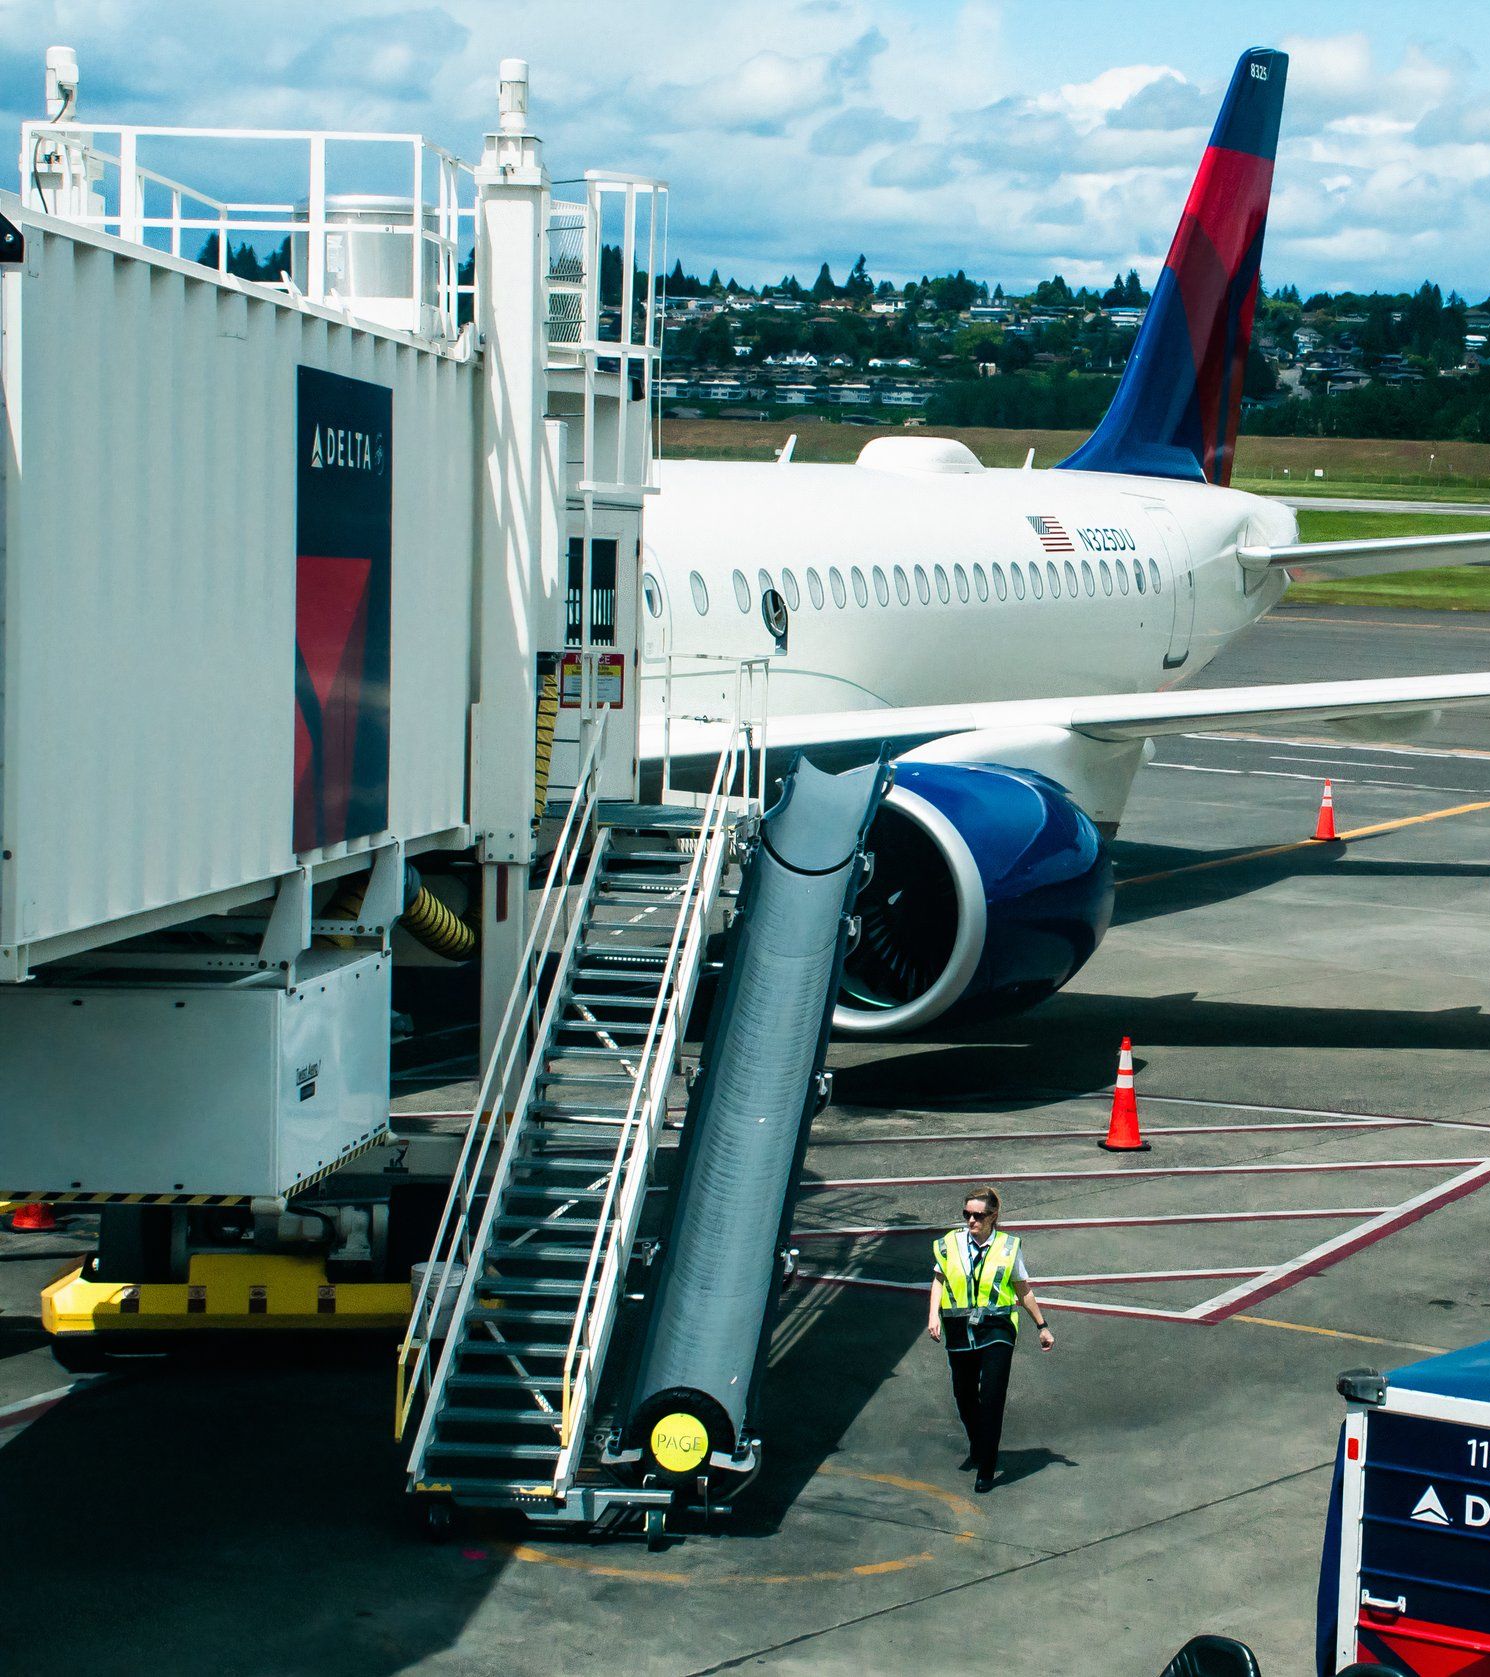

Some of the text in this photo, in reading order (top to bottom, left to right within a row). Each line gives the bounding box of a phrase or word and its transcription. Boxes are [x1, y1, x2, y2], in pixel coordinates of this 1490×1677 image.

[1250, 62, 1267, 81] 8325
[327, 427, 371, 470] DELTA
[1076, 528, 1136, 551] N325DU
[657, 1433, 704, 1453] PAGE
